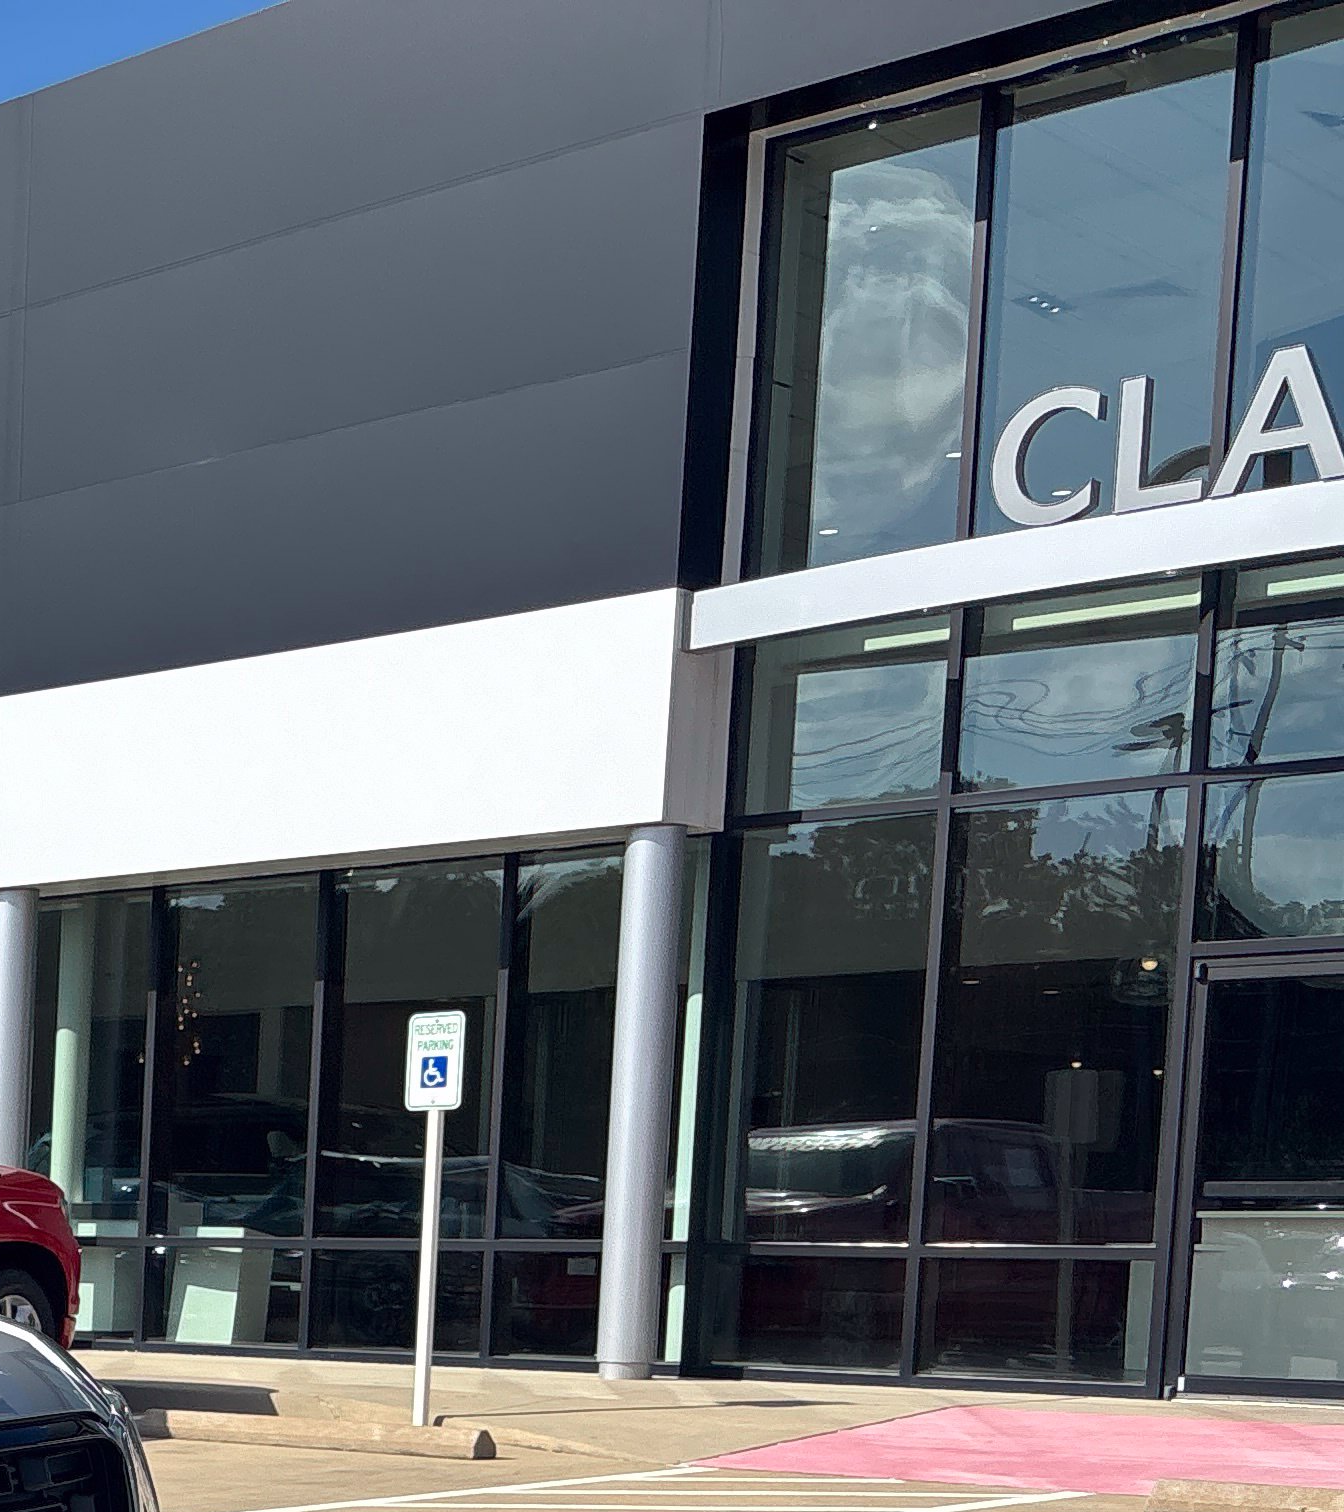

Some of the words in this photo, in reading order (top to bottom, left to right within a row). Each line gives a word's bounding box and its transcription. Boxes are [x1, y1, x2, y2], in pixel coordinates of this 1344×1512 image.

[992, 344, 1344, 526] CLA
[415, 1023, 458, 1035] RESERVED
[417, 1039, 454, 1051] PARKING
